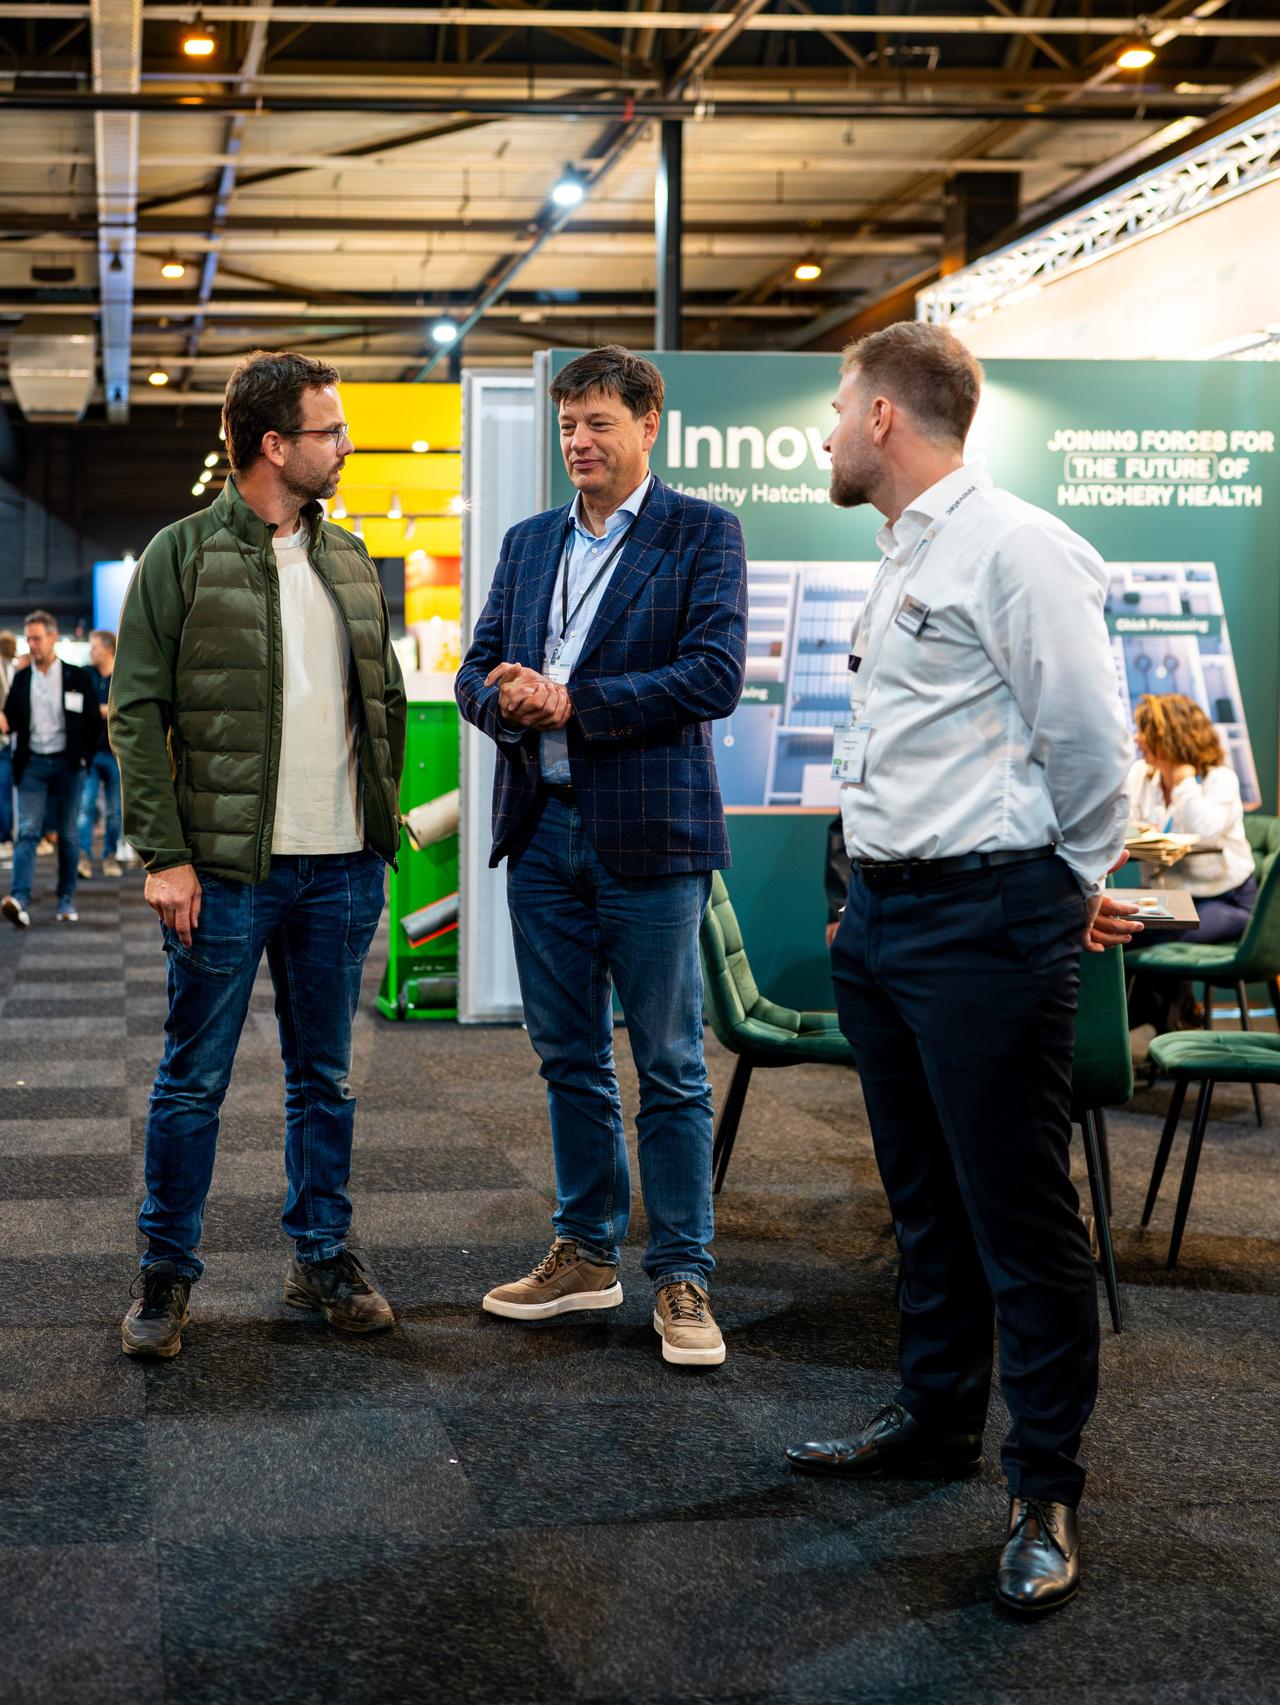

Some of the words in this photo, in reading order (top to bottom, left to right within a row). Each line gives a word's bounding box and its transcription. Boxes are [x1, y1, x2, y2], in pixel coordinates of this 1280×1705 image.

[1047, 429, 1138, 451] JOINING
[1141, 429, 1228, 452] FORCES
[1230, 430, 1275, 452] FOR
[1072, 457, 1118, 479] THE
[1125, 457, 1211, 479] FUTURE
[1218, 457, 1250, 480] OF
[752, 482, 840, 508] Hatche
[1057, 484, 1175, 506] HATCHERY
[1177, 484, 1262, 507] HEALTH
